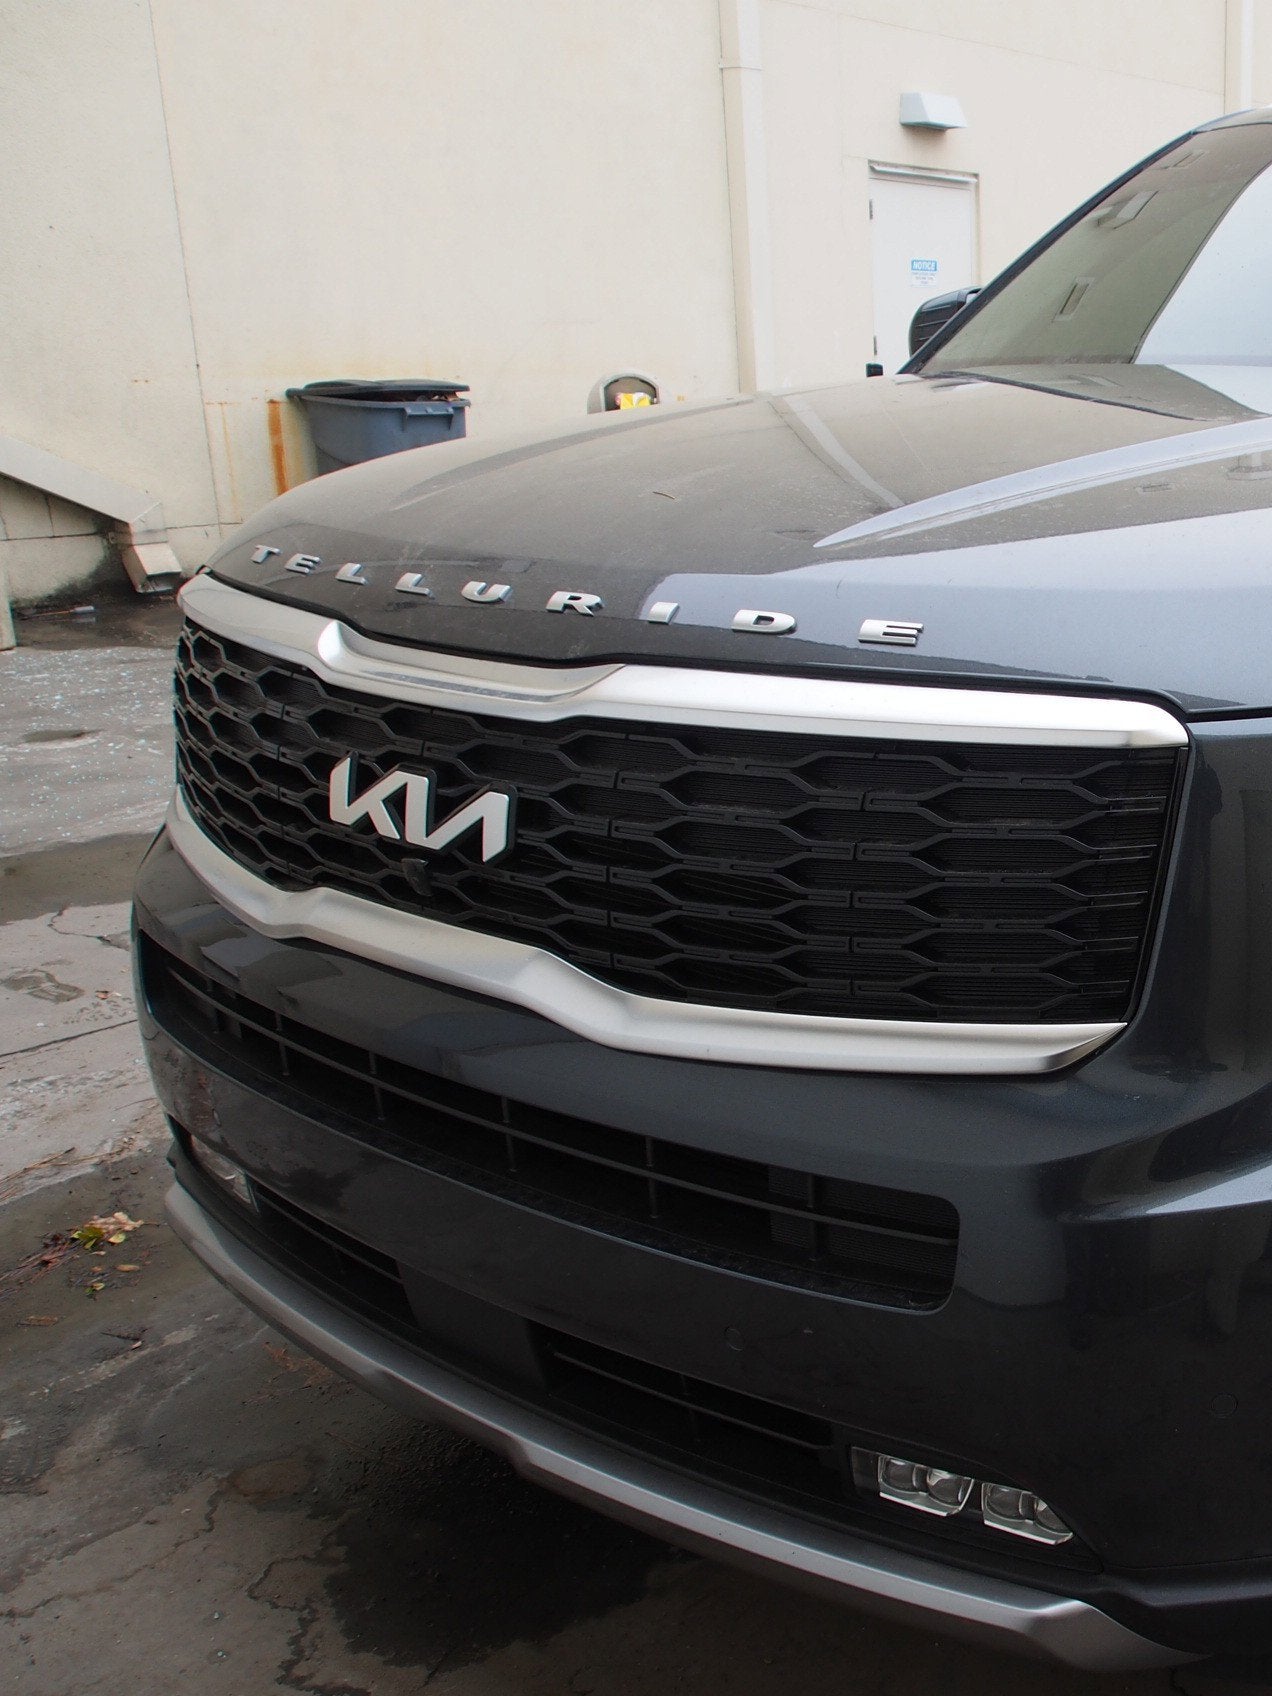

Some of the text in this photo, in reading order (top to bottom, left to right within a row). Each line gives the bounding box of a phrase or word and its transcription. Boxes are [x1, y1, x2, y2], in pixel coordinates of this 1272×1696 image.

[913, 261, 936, 270] NOTICE
[252, 544, 924, 646] TELLURIDE
[329, 756, 510, 863] KIA
